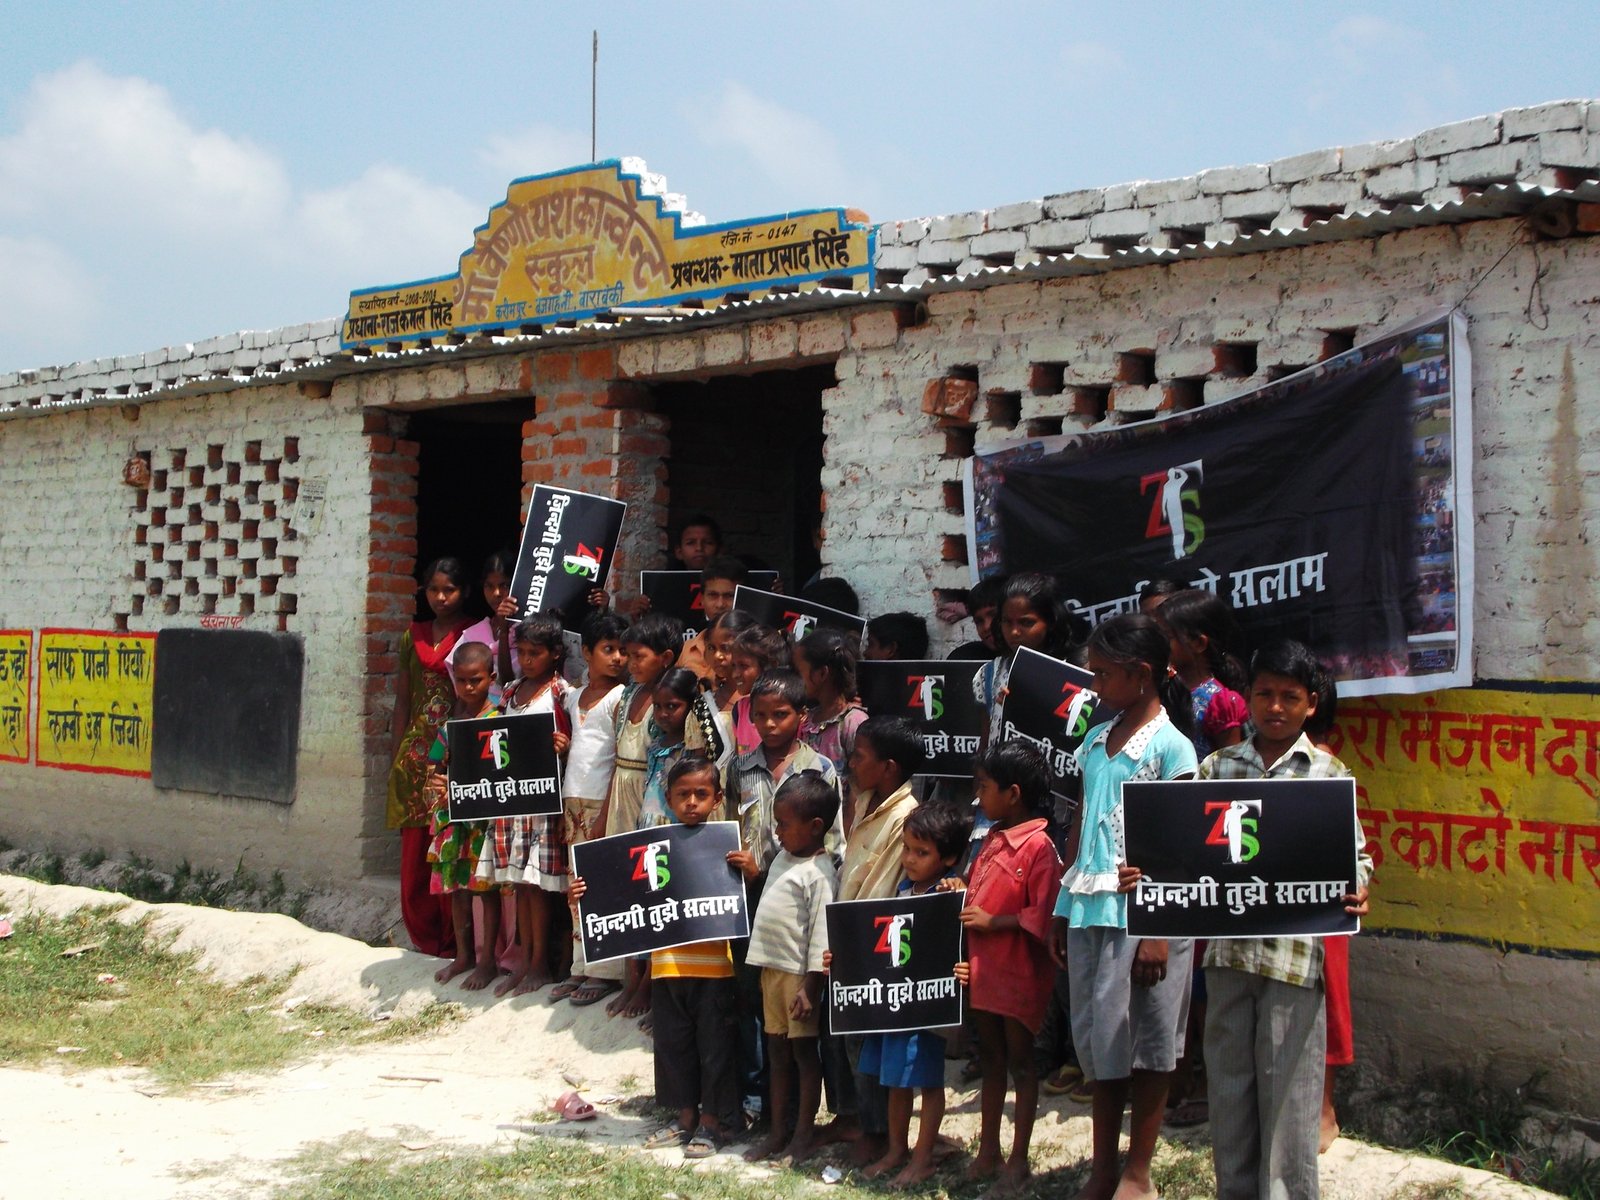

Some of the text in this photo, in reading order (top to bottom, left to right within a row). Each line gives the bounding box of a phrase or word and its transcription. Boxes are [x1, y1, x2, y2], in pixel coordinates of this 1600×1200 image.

[767, 224, 797, 240] 0147
[525, 245, 596, 296] स्कूल
[766, 241, 812, 276] प्रसाद
[811, 228, 851, 269] सिंह
[428, 297, 453, 329] सिंह
[533, 547, 554, 573] तुझे
[1229, 552, 1329, 609] सलाम
[80, 640, 110, 681] पानी
[923, 729, 950, 759] तुझे
[1399, 697, 1544, 777] मंजन
[493, 776, 517, 803] तुझे
[518, 776, 556, 796] सलाम
[1390, 787, 1513, 876] काटो
[648, 897, 680, 932] तुझे
[683, 895, 740, 918] सलाम
[1225, 875, 1269, 915] तुझे
[1274, 880, 1349, 905] सलाम
[887, 977, 913, 1011] तुझे
[916, 976, 956, 1001] सलाम
